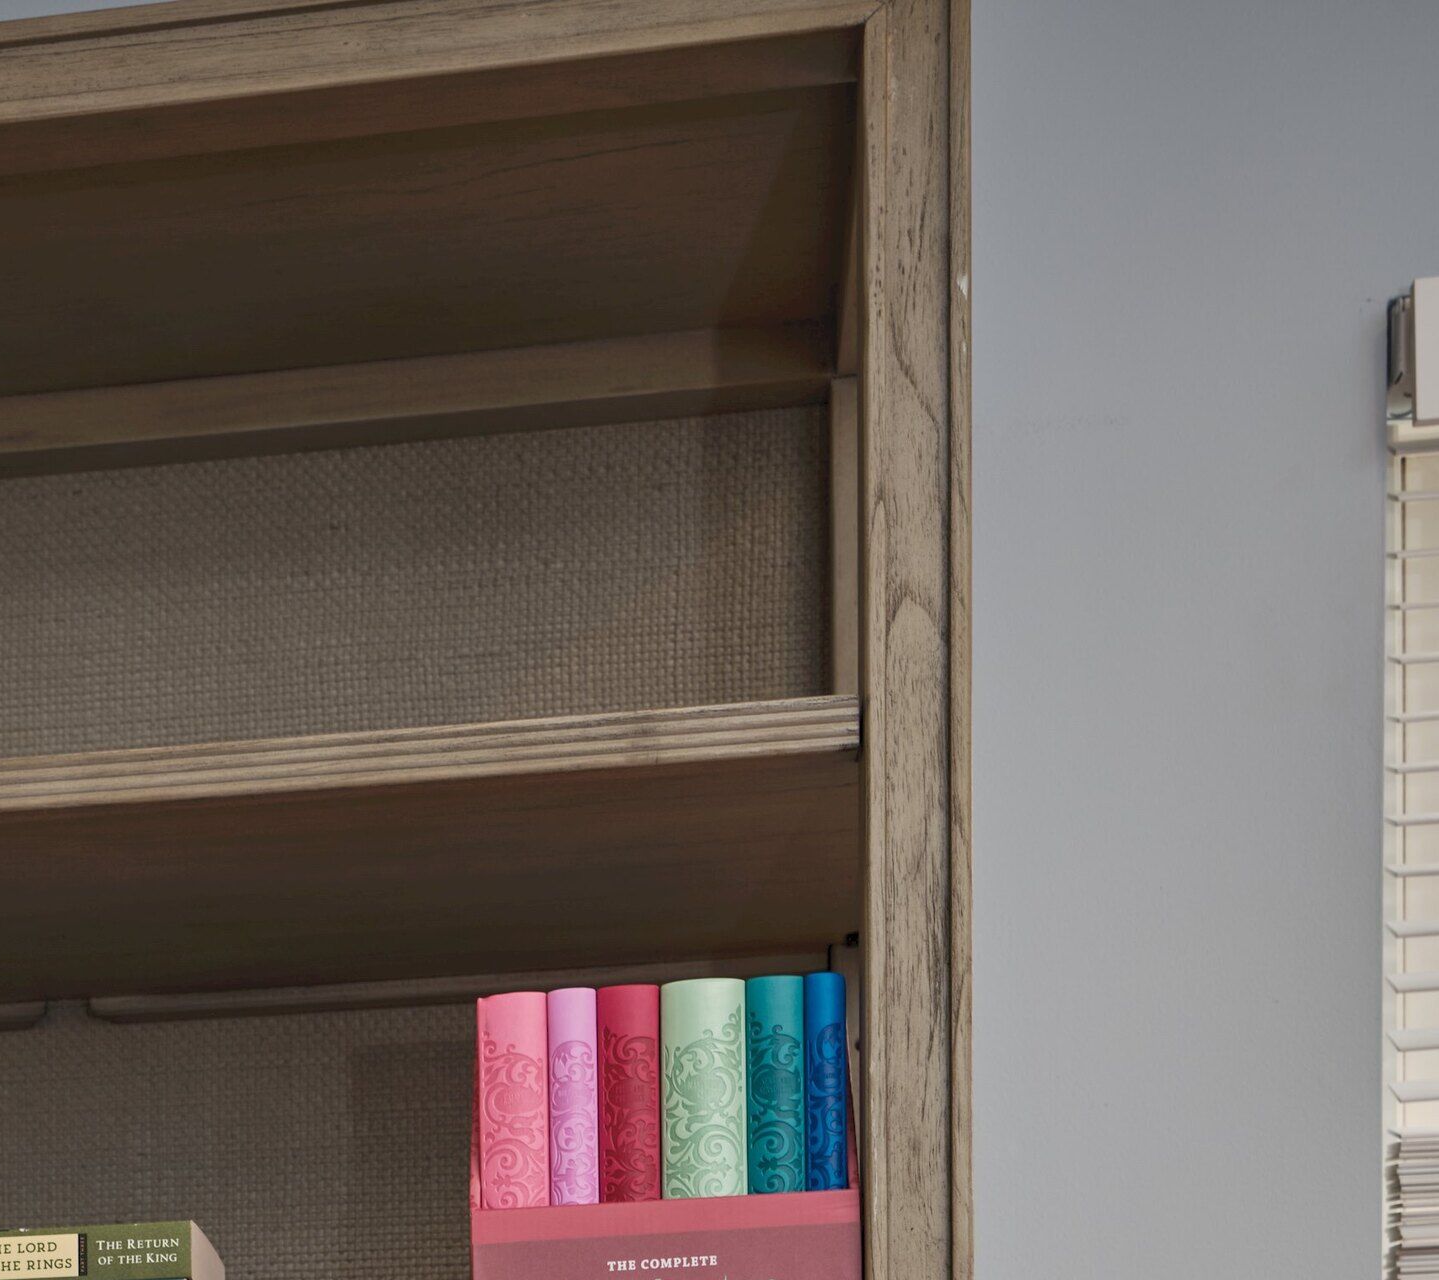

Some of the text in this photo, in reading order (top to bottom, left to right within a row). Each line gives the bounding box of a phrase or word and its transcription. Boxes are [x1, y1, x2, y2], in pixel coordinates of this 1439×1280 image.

[18, 1242, 57, 1253] LORD
[27, 1258, 72, 1270] RINGS
[607, 1255, 718, 1272] THE COMPLETE
